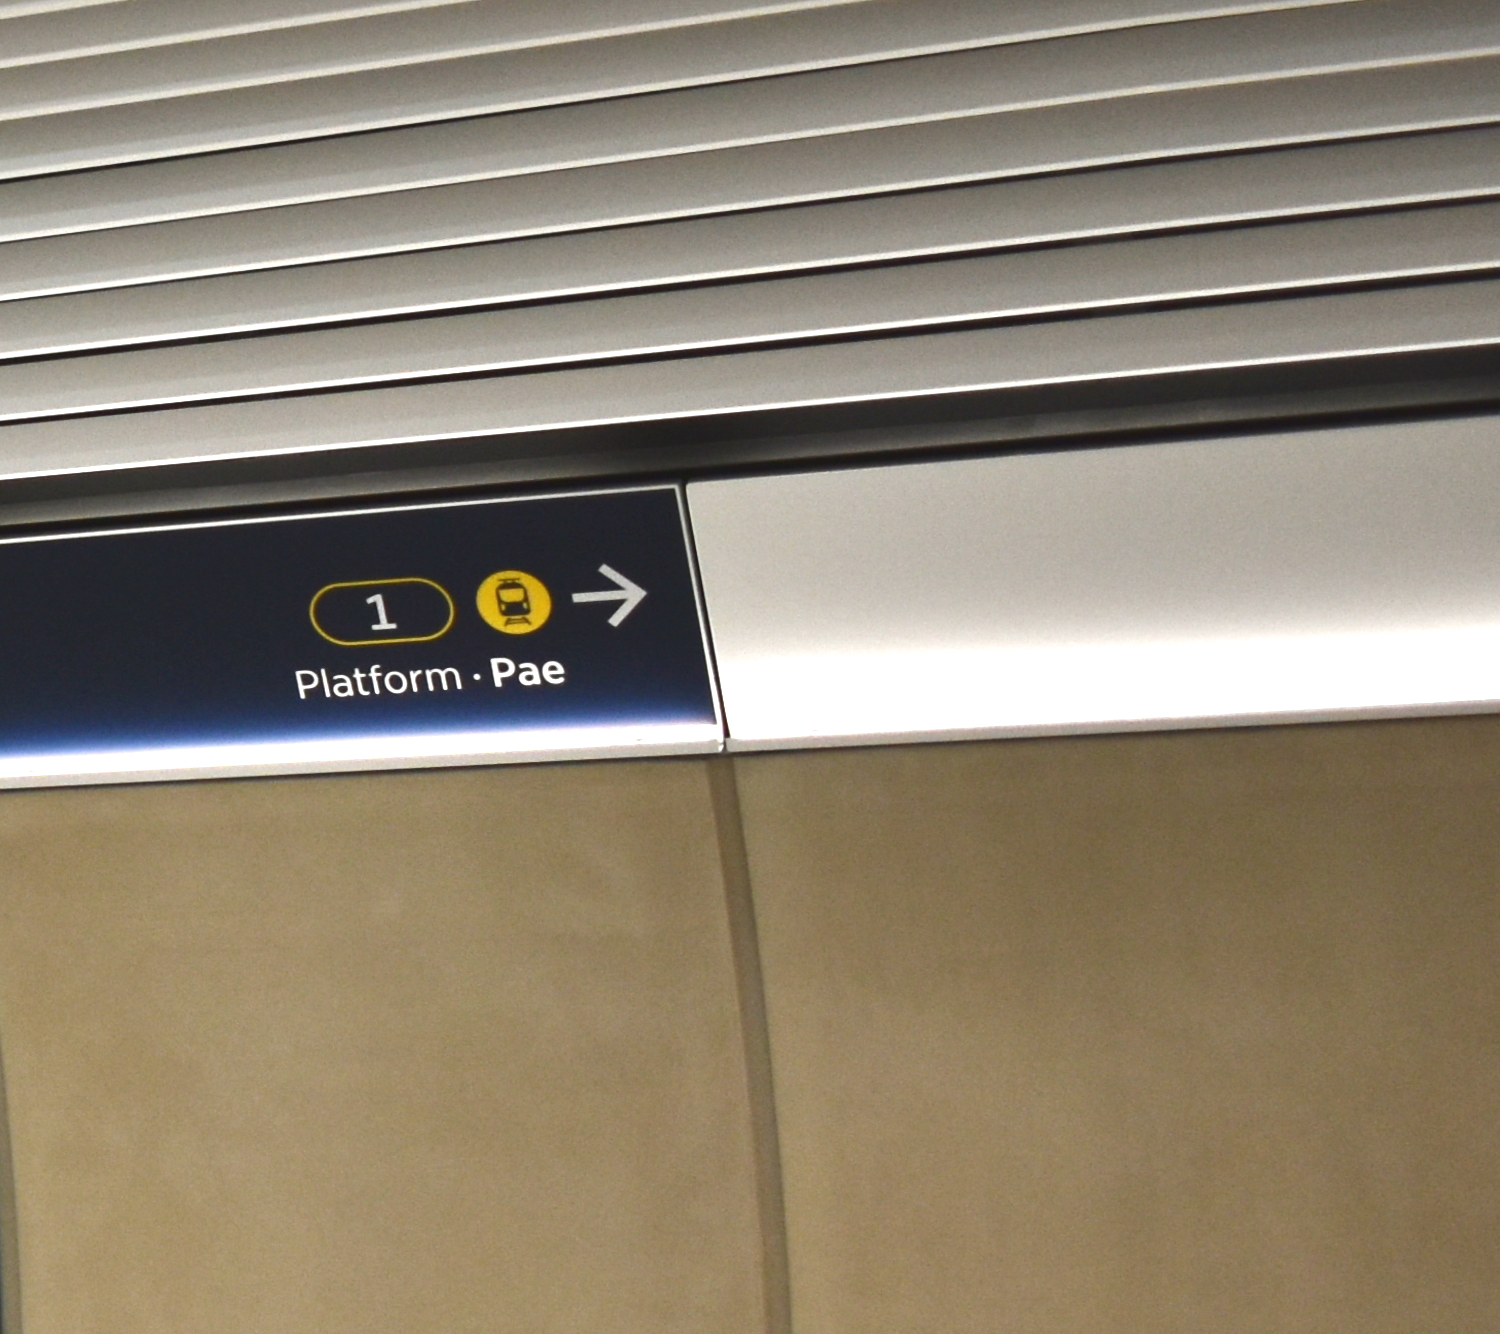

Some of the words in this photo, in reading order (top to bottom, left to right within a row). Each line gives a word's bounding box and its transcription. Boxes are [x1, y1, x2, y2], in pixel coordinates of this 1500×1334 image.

[365, 593, 398, 632] 1
[294, 664, 463, 700] Platform
[489, 656, 567, 688] Pae
